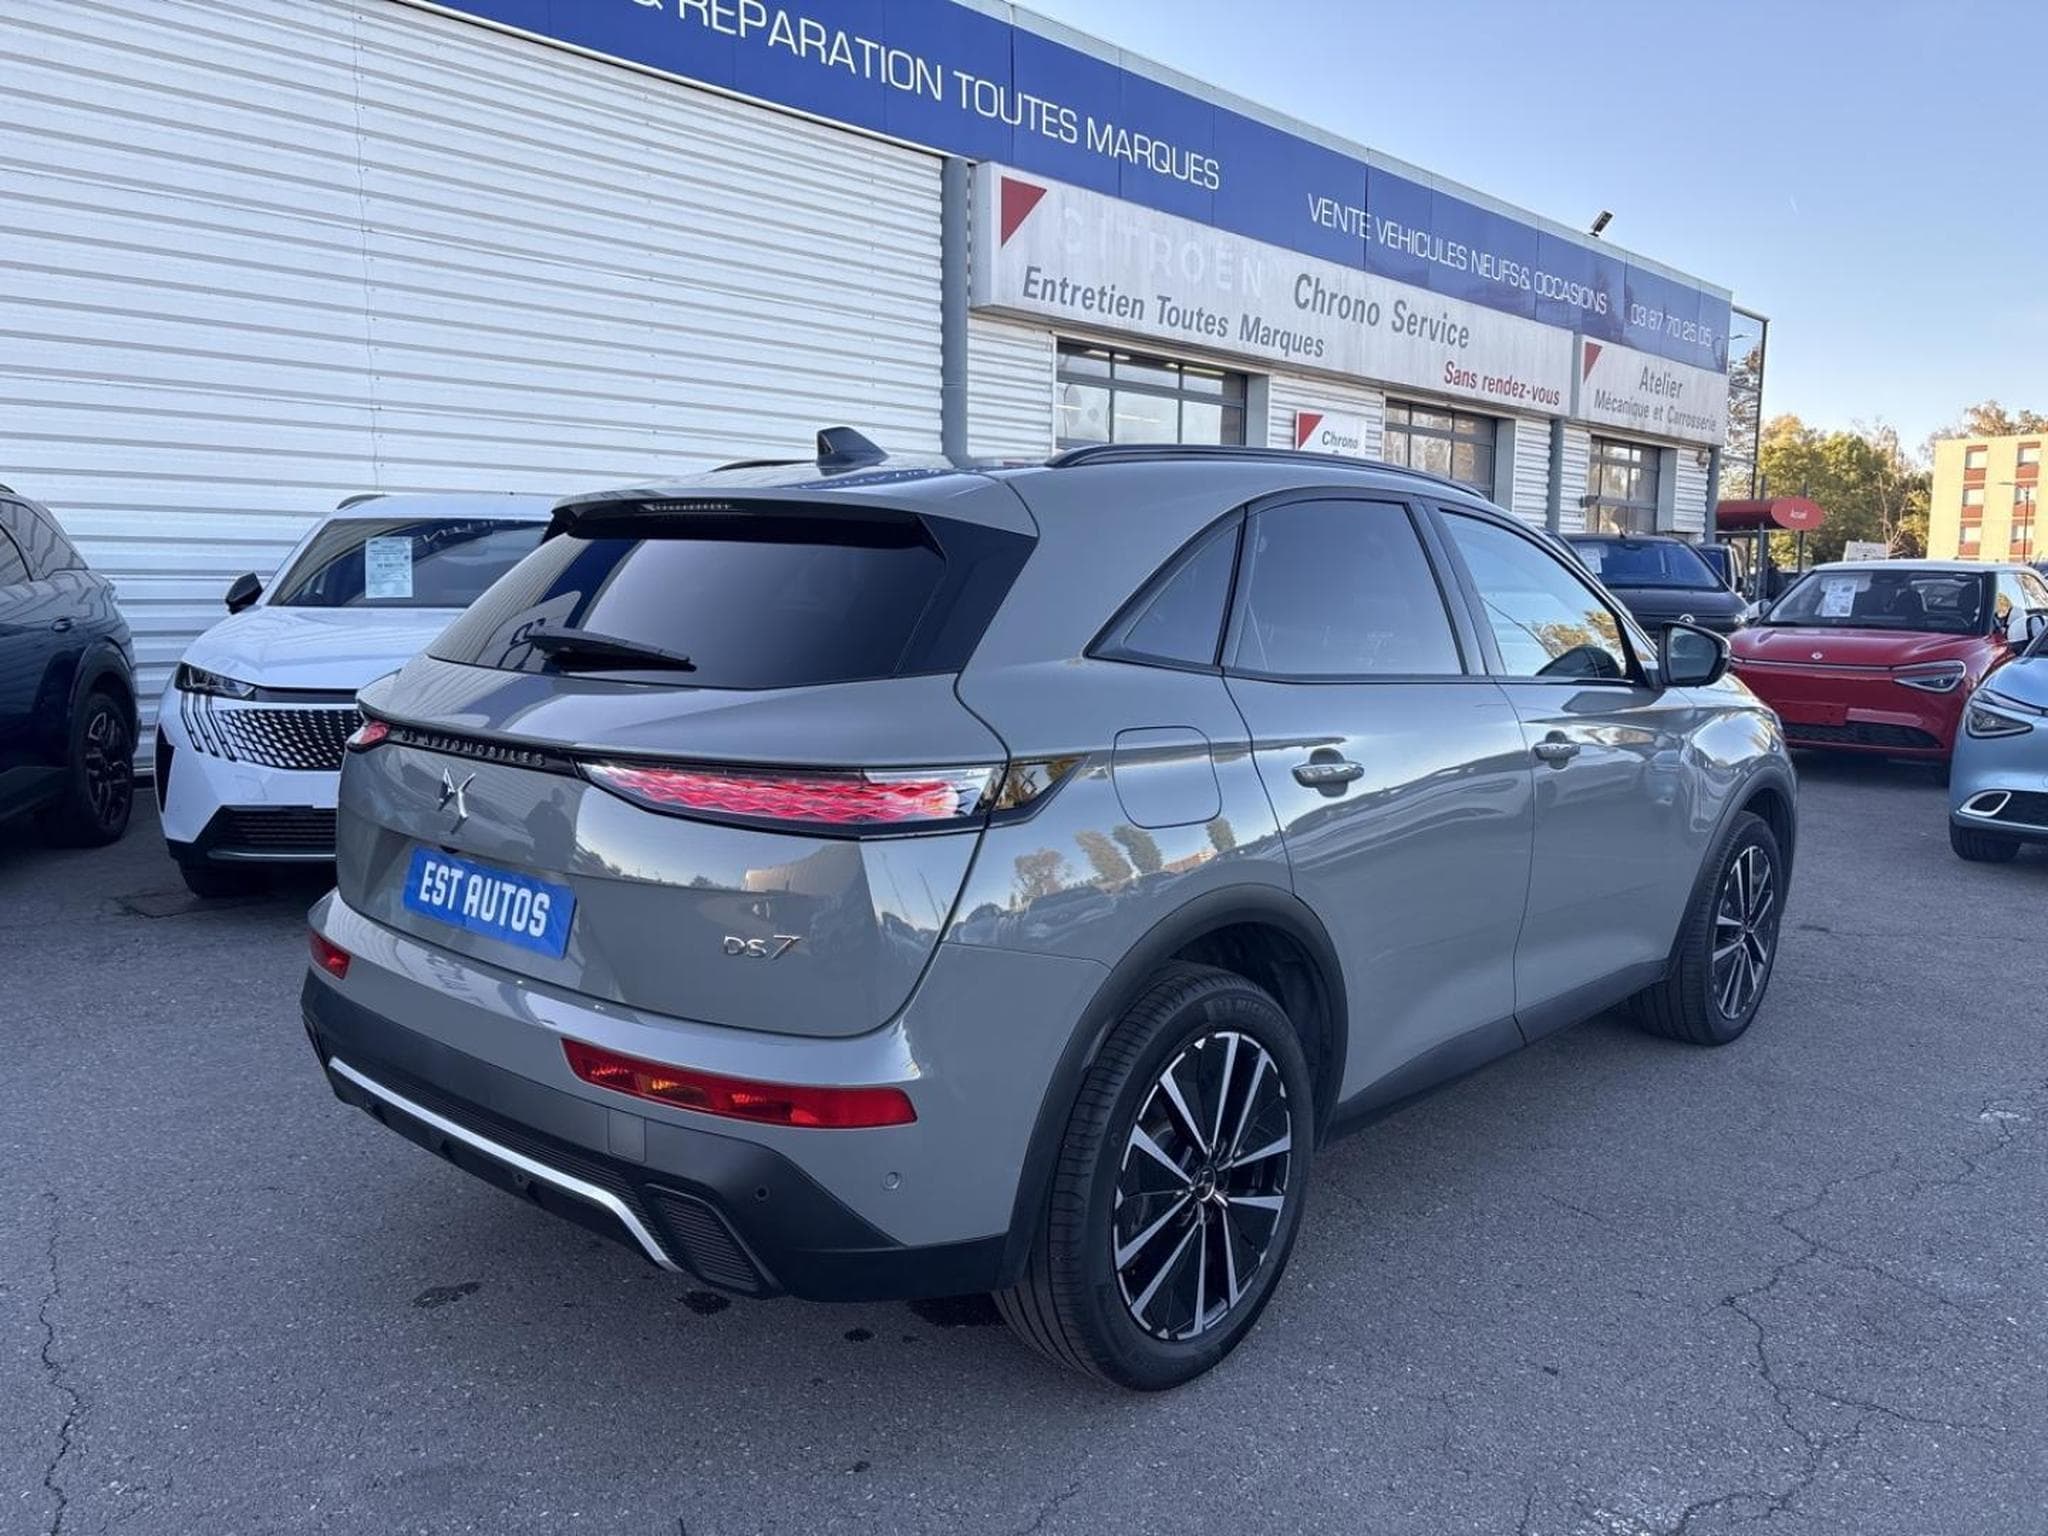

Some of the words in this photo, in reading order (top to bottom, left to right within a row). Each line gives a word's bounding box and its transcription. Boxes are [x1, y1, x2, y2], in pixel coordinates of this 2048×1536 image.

[953, 70, 1077, 144] TOUTES
[1087, 116, 1219, 190] MARQUES
[1308, 193, 1371, 239] VENTE
[1375, 216, 1467, 271] VEHICULES
[1534, 271, 1607, 314] OCCASIONS
[1022, 266, 1144, 321] Entretien
[1156, 295, 1228, 337] Toutes
[1238, 313, 1324, 358] Marques
[1294, 273, 1380, 326] Chrono
[1391, 299, 1469, 349] Service
[1631, 303, 1646, 327] 03
[1444, 361, 1477, 389] Sans
[1482, 374, 1560, 406] rendez-vous
[1594, 389, 1650, 421] Mécanique
[1653, 405, 1663, 422] et
[1667, 405, 1717, 432] Carrosserie
[1639, 365, 1684, 399] Atelier
[1322, 430, 1359, 449] Chrono
[419, 860, 464, 910] EST
[463, 874, 550, 937] AUTOS
